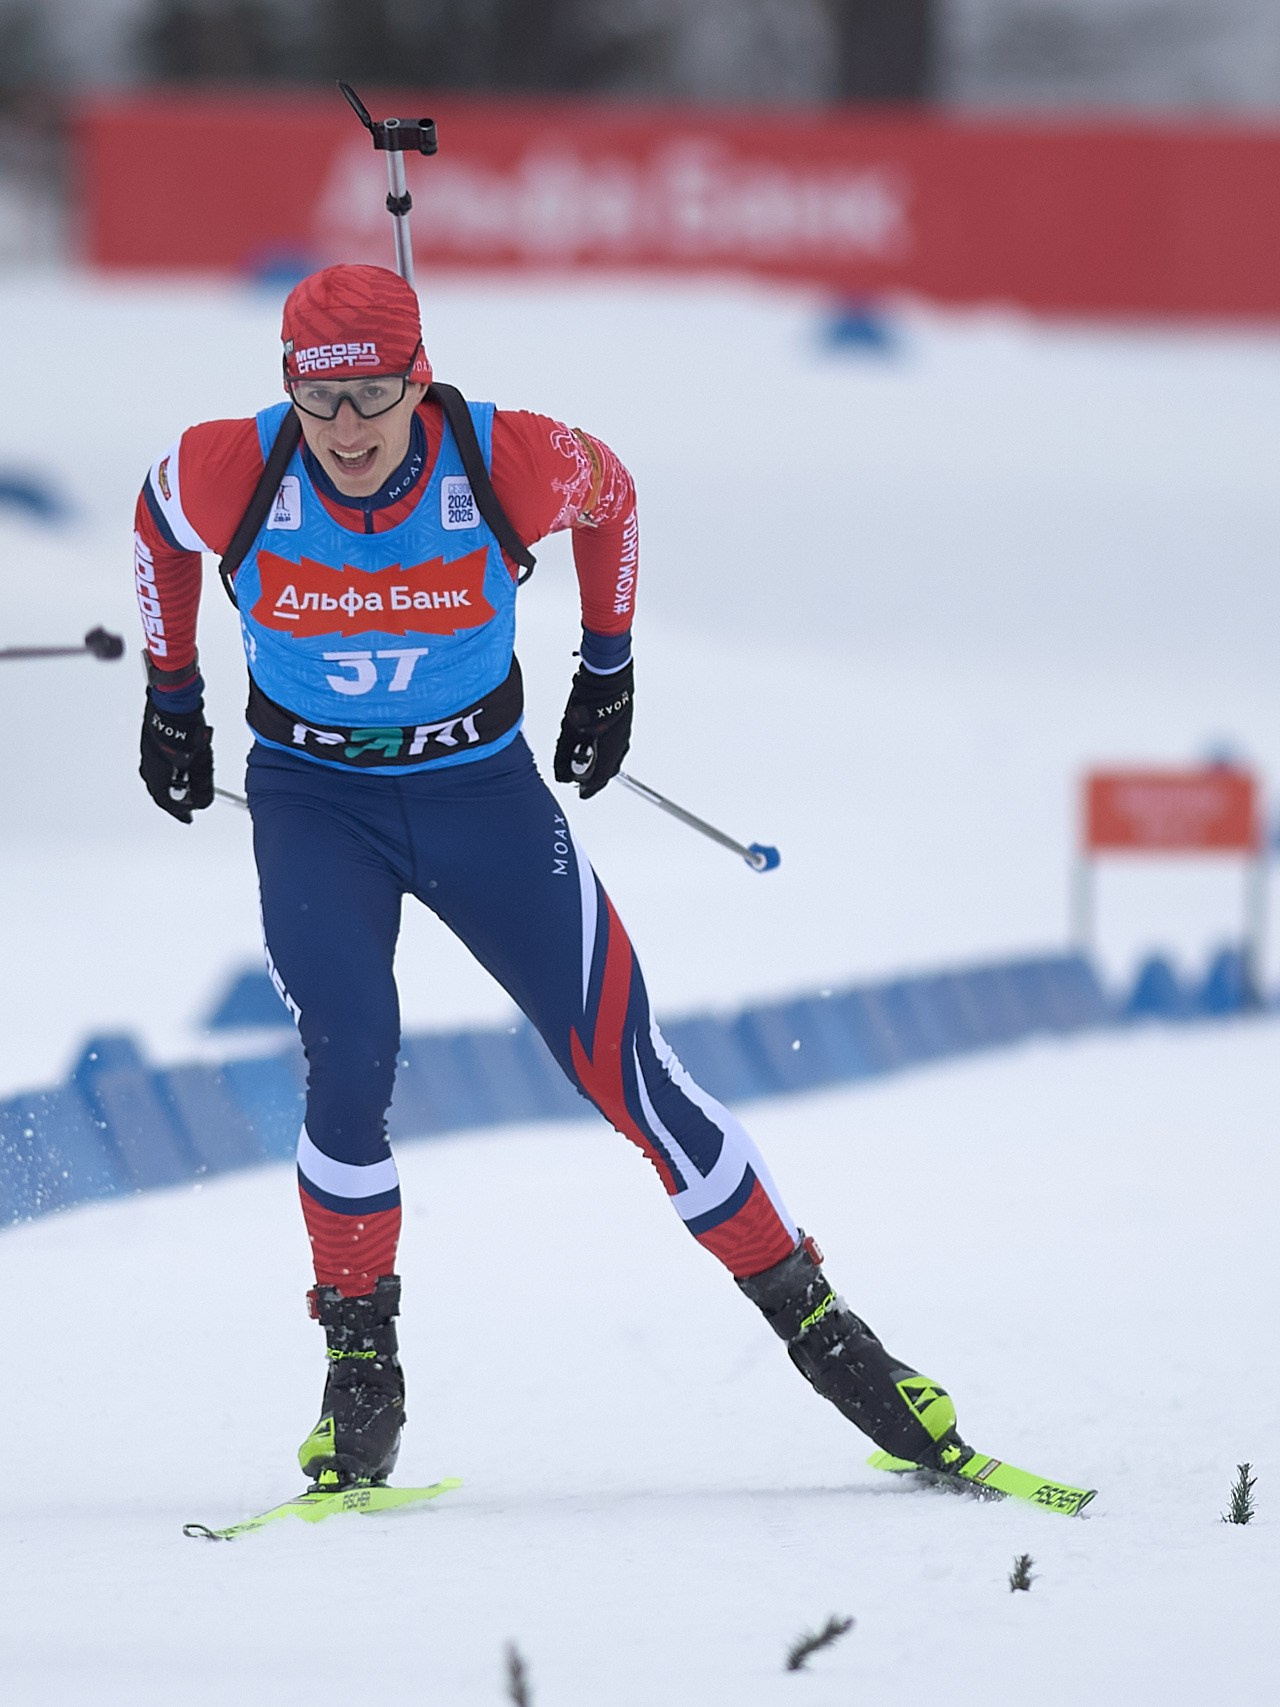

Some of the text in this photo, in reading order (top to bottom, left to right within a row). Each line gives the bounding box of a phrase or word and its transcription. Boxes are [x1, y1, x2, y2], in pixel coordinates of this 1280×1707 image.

[295, 342, 376, 363] МОСОБЛ
[298, 354, 358, 374] СПОРТ
[448, 495, 474, 508] 2024
[448, 509, 474, 523] 2025
[274, 585, 472, 617] Альфа Банк
[323, 648, 429, 696] 37
[597, 696, 629, 719] MOAX
[152, 717, 187, 740] MOAX
[552, 814, 569, 876] MOAX
